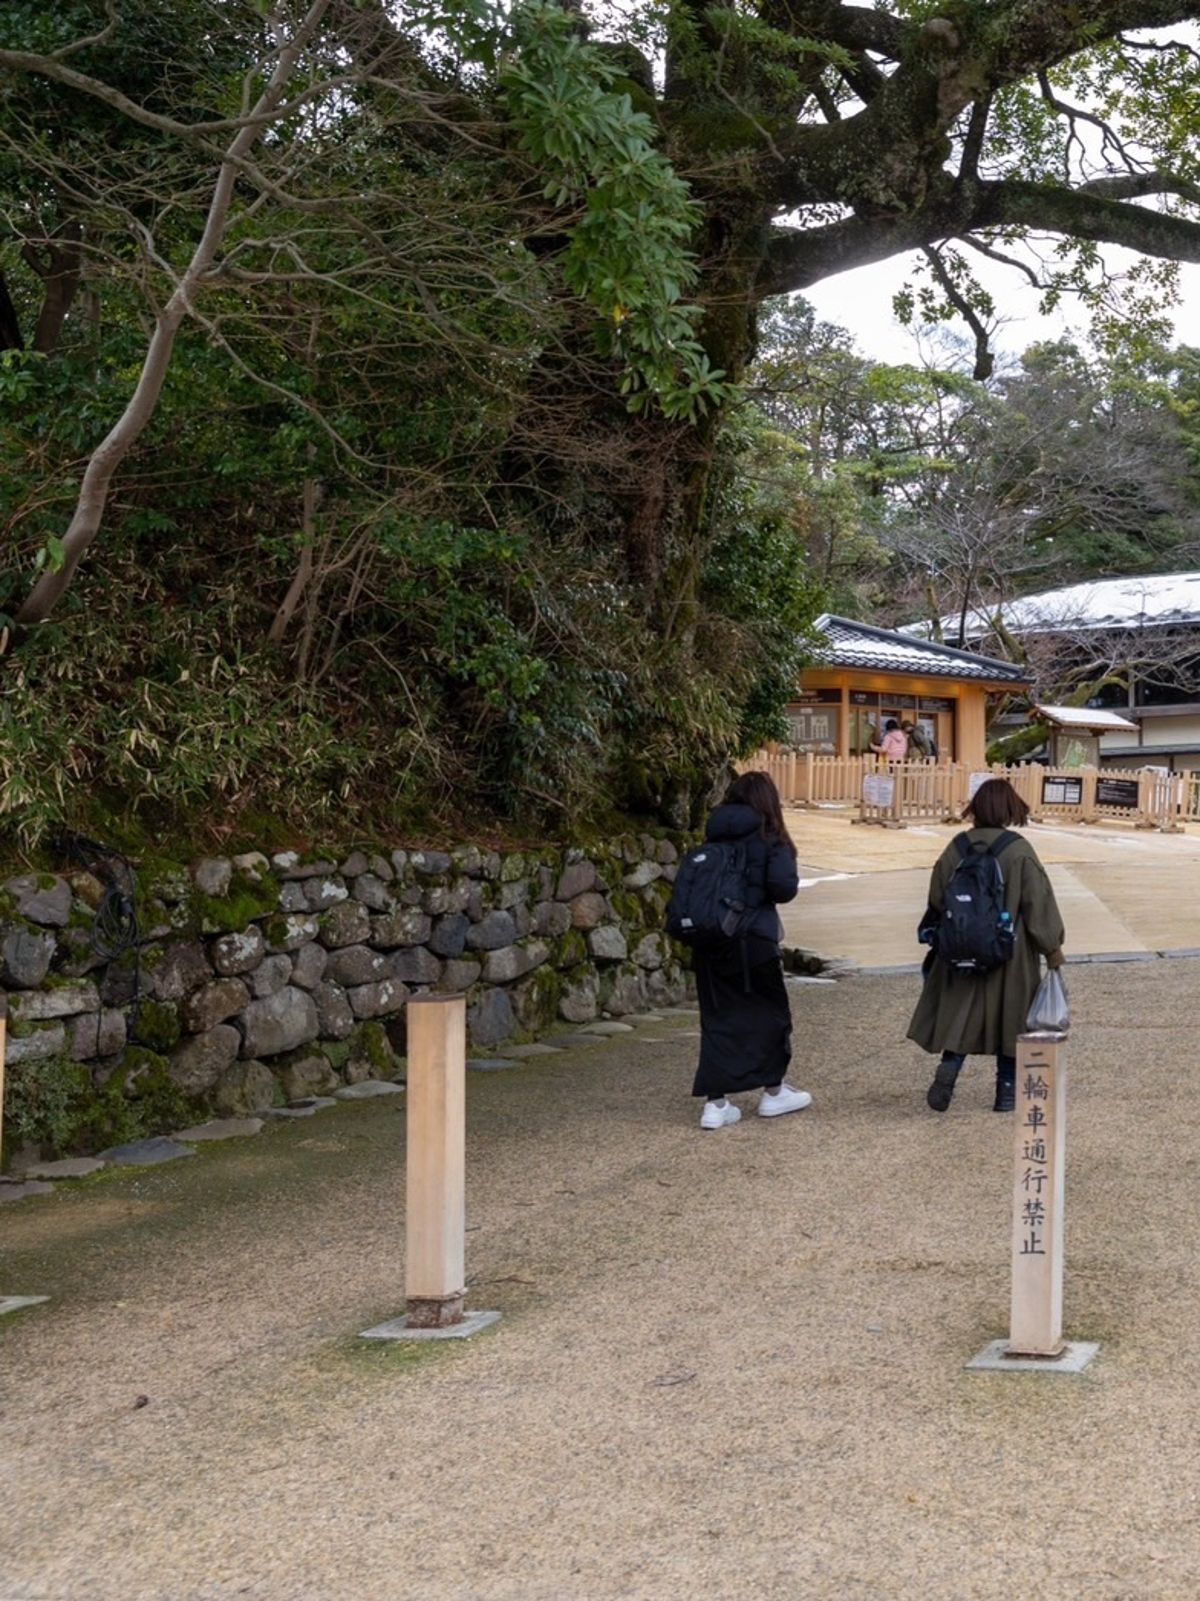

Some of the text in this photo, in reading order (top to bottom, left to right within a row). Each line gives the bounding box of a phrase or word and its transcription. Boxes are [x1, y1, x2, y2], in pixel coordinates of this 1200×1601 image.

[1019, 1051, 1051, 1256] 二輪車通行禁止
